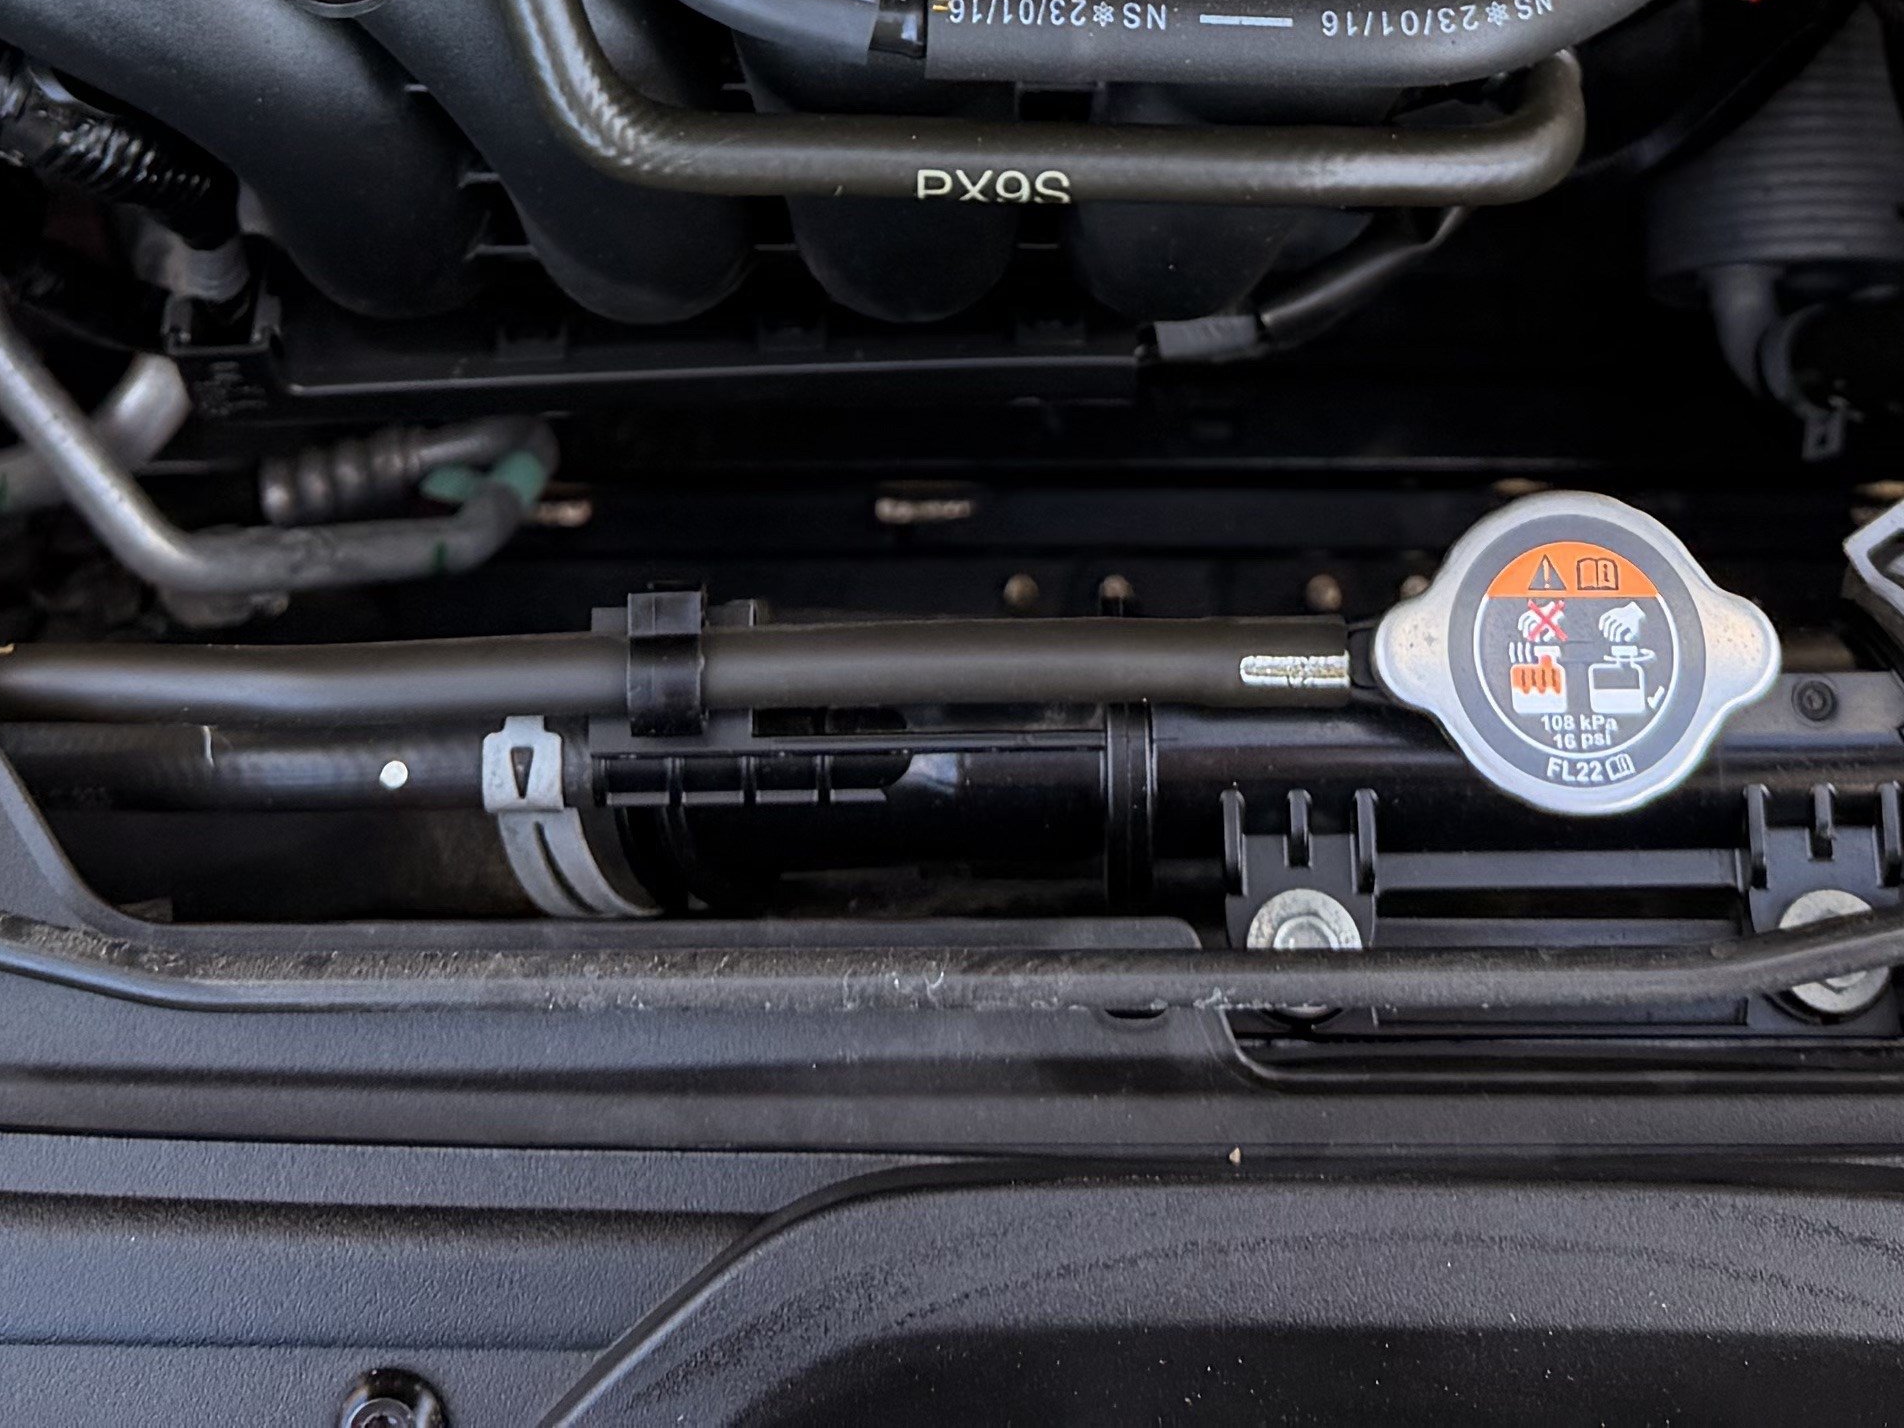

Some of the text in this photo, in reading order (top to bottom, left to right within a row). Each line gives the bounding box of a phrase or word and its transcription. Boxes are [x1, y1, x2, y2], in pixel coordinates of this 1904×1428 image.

[1320, 3, 1479, 38] 23/01/16
[917, 168, 1072, 204] PX9S
[1540, 713, 1619, 732] 108 kPa
[1552, 730, 1612, 752] 16 psi
[1547, 757, 1604, 781] FL22
